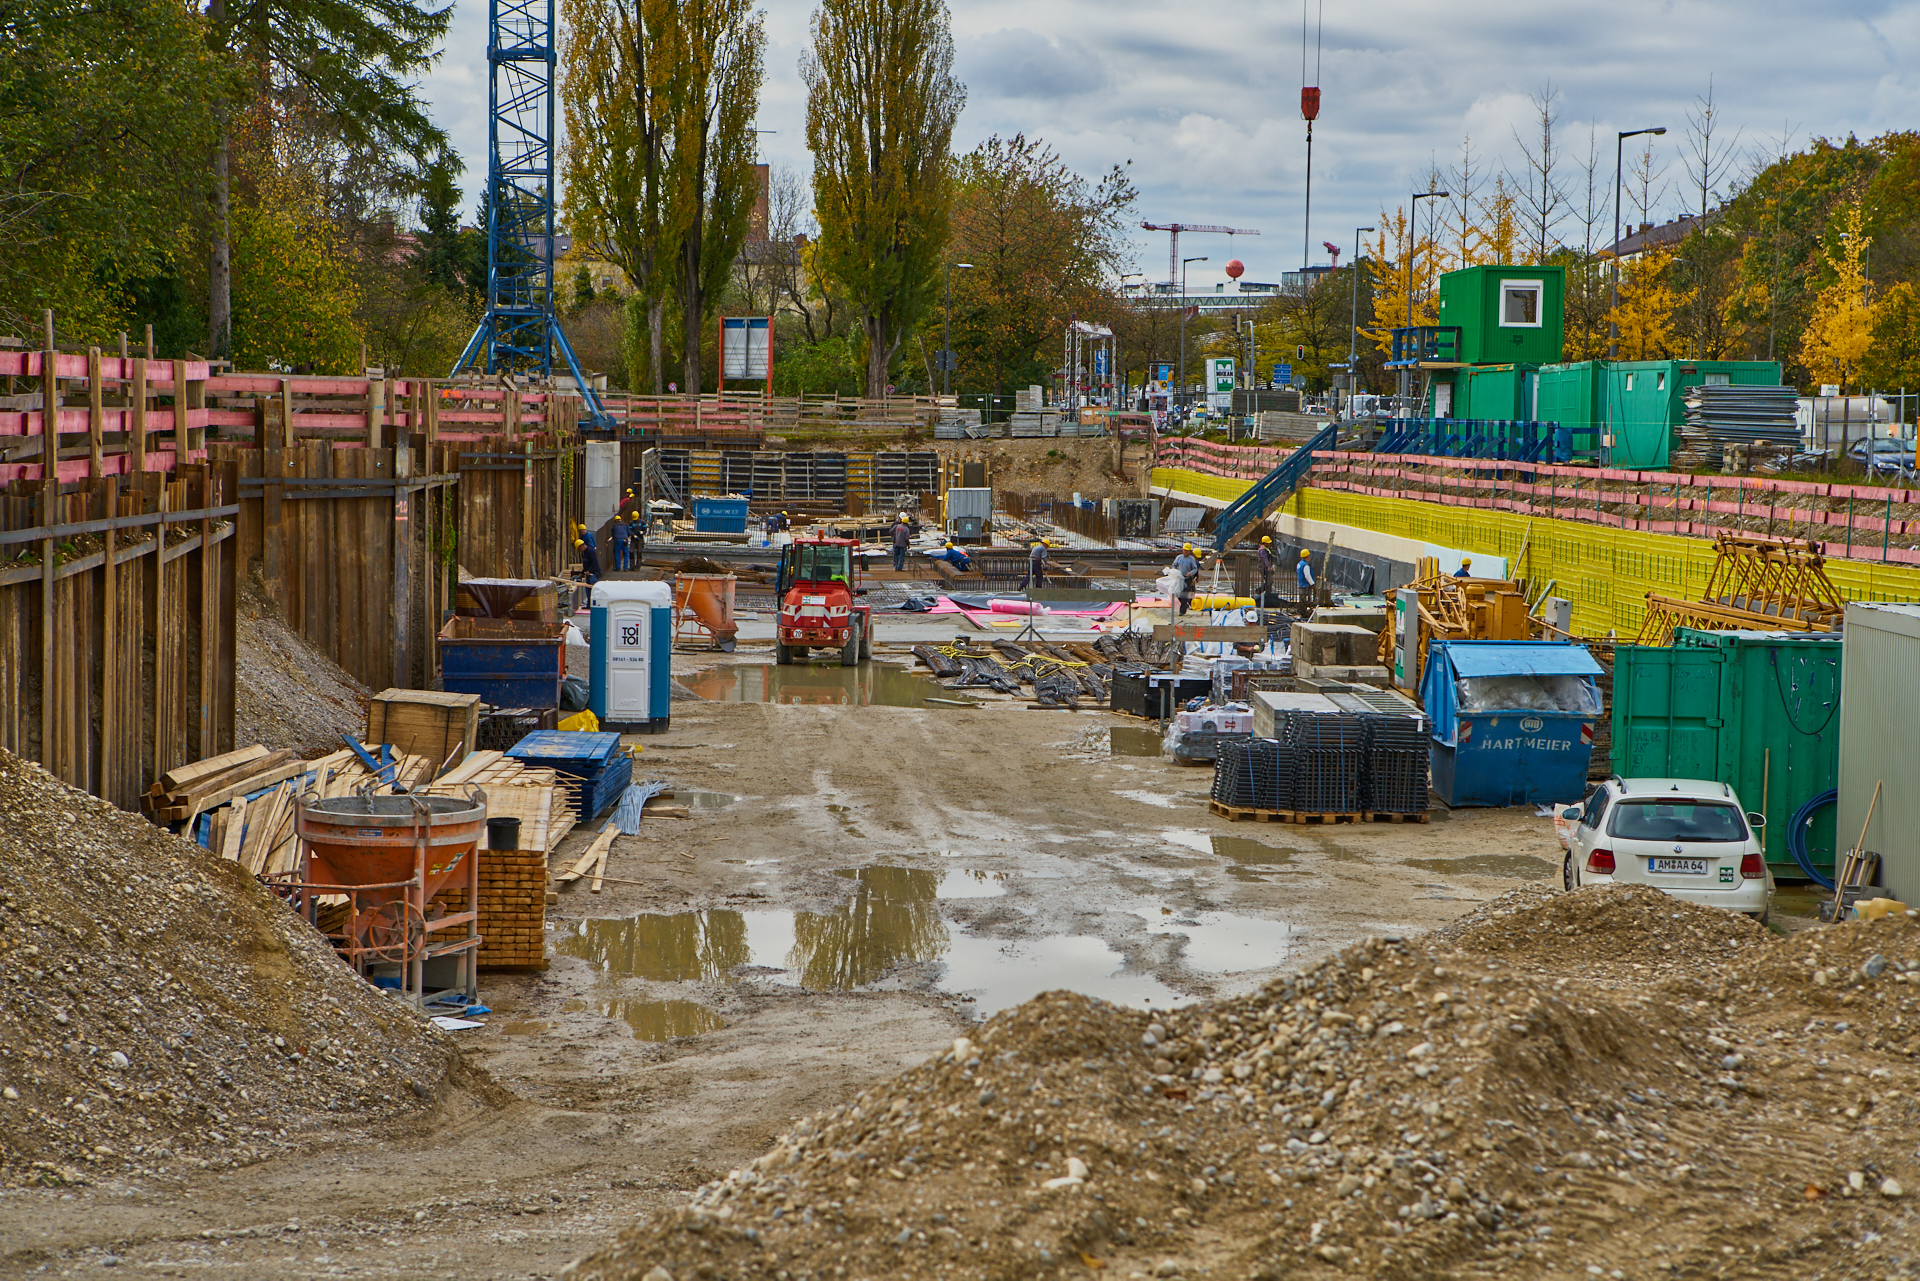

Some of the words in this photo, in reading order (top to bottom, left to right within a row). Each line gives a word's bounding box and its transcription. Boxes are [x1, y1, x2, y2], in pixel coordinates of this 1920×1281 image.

[621, 626, 639, 636] TOI
[621, 636, 639, 645] TOI
[1480, 737, 1572, 751] HARTMEIER
[1658, 859, 1671, 870] AM
[1676, 860, 1690, 870] AA
[1691, 860, 1703, 871] 64
